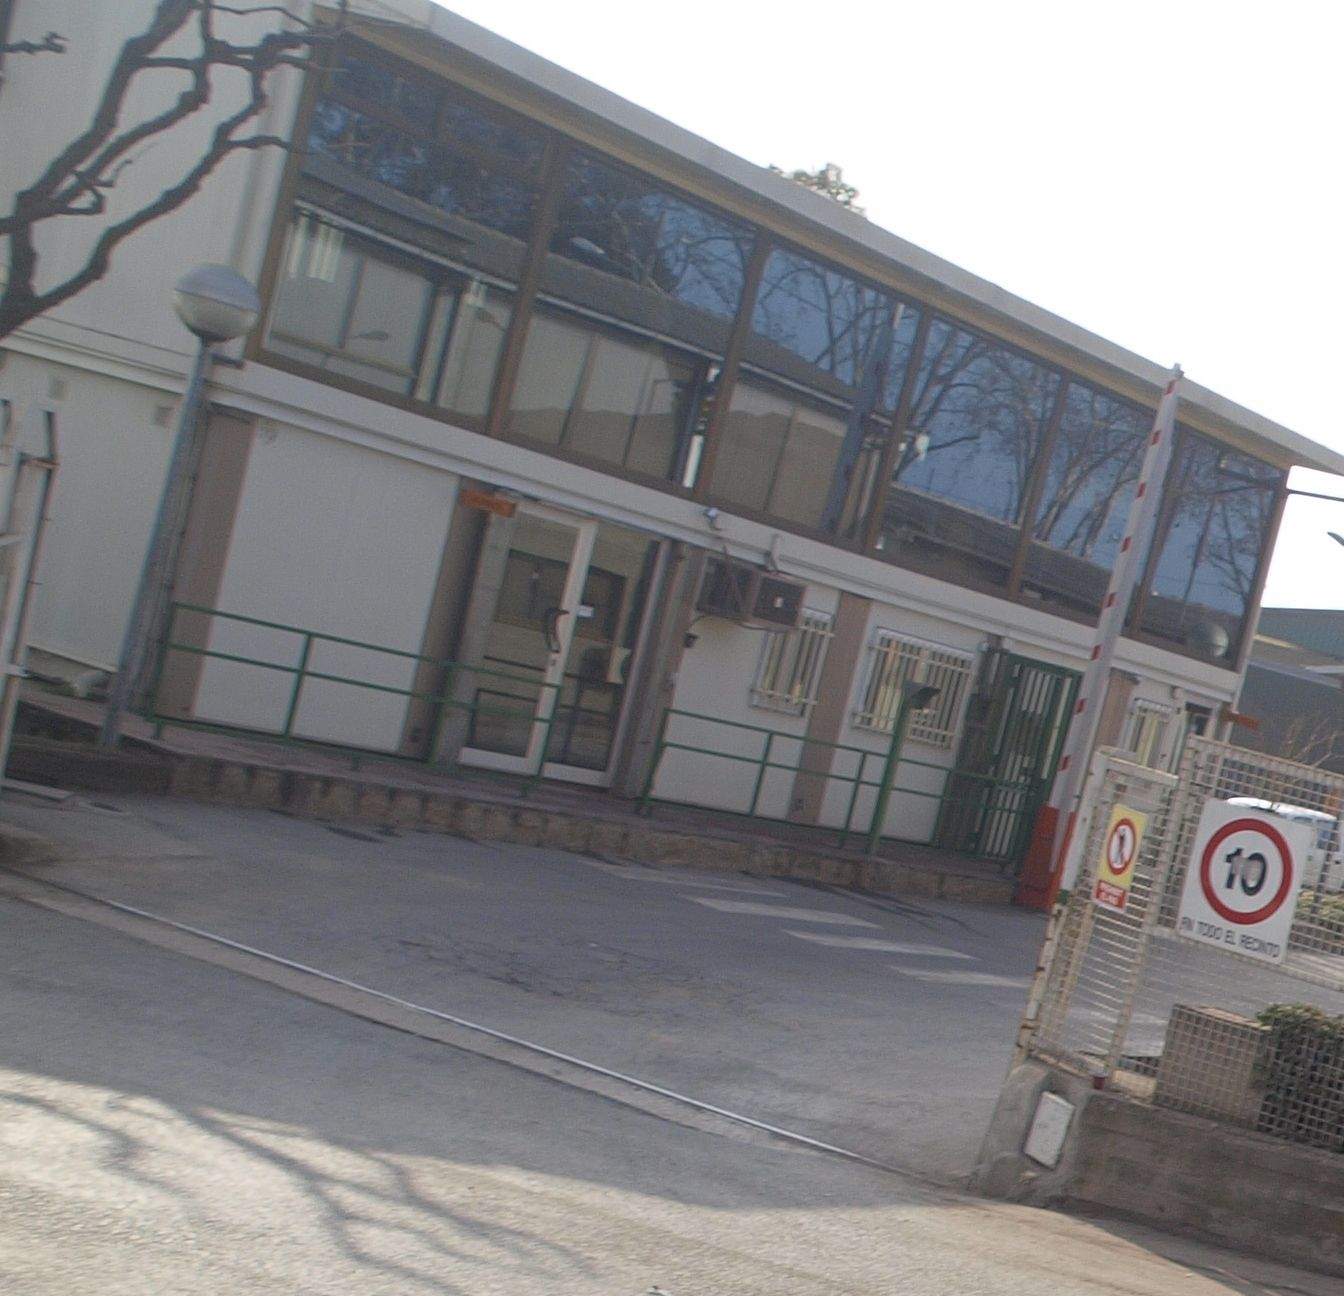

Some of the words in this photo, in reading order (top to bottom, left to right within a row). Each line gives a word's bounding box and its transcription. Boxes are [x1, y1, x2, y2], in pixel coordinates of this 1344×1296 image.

[1225, 847, 1267, 896] 10
[1225, 930, 1236, 945] EL
[1240, 934, 1280, 958] RECINTO
